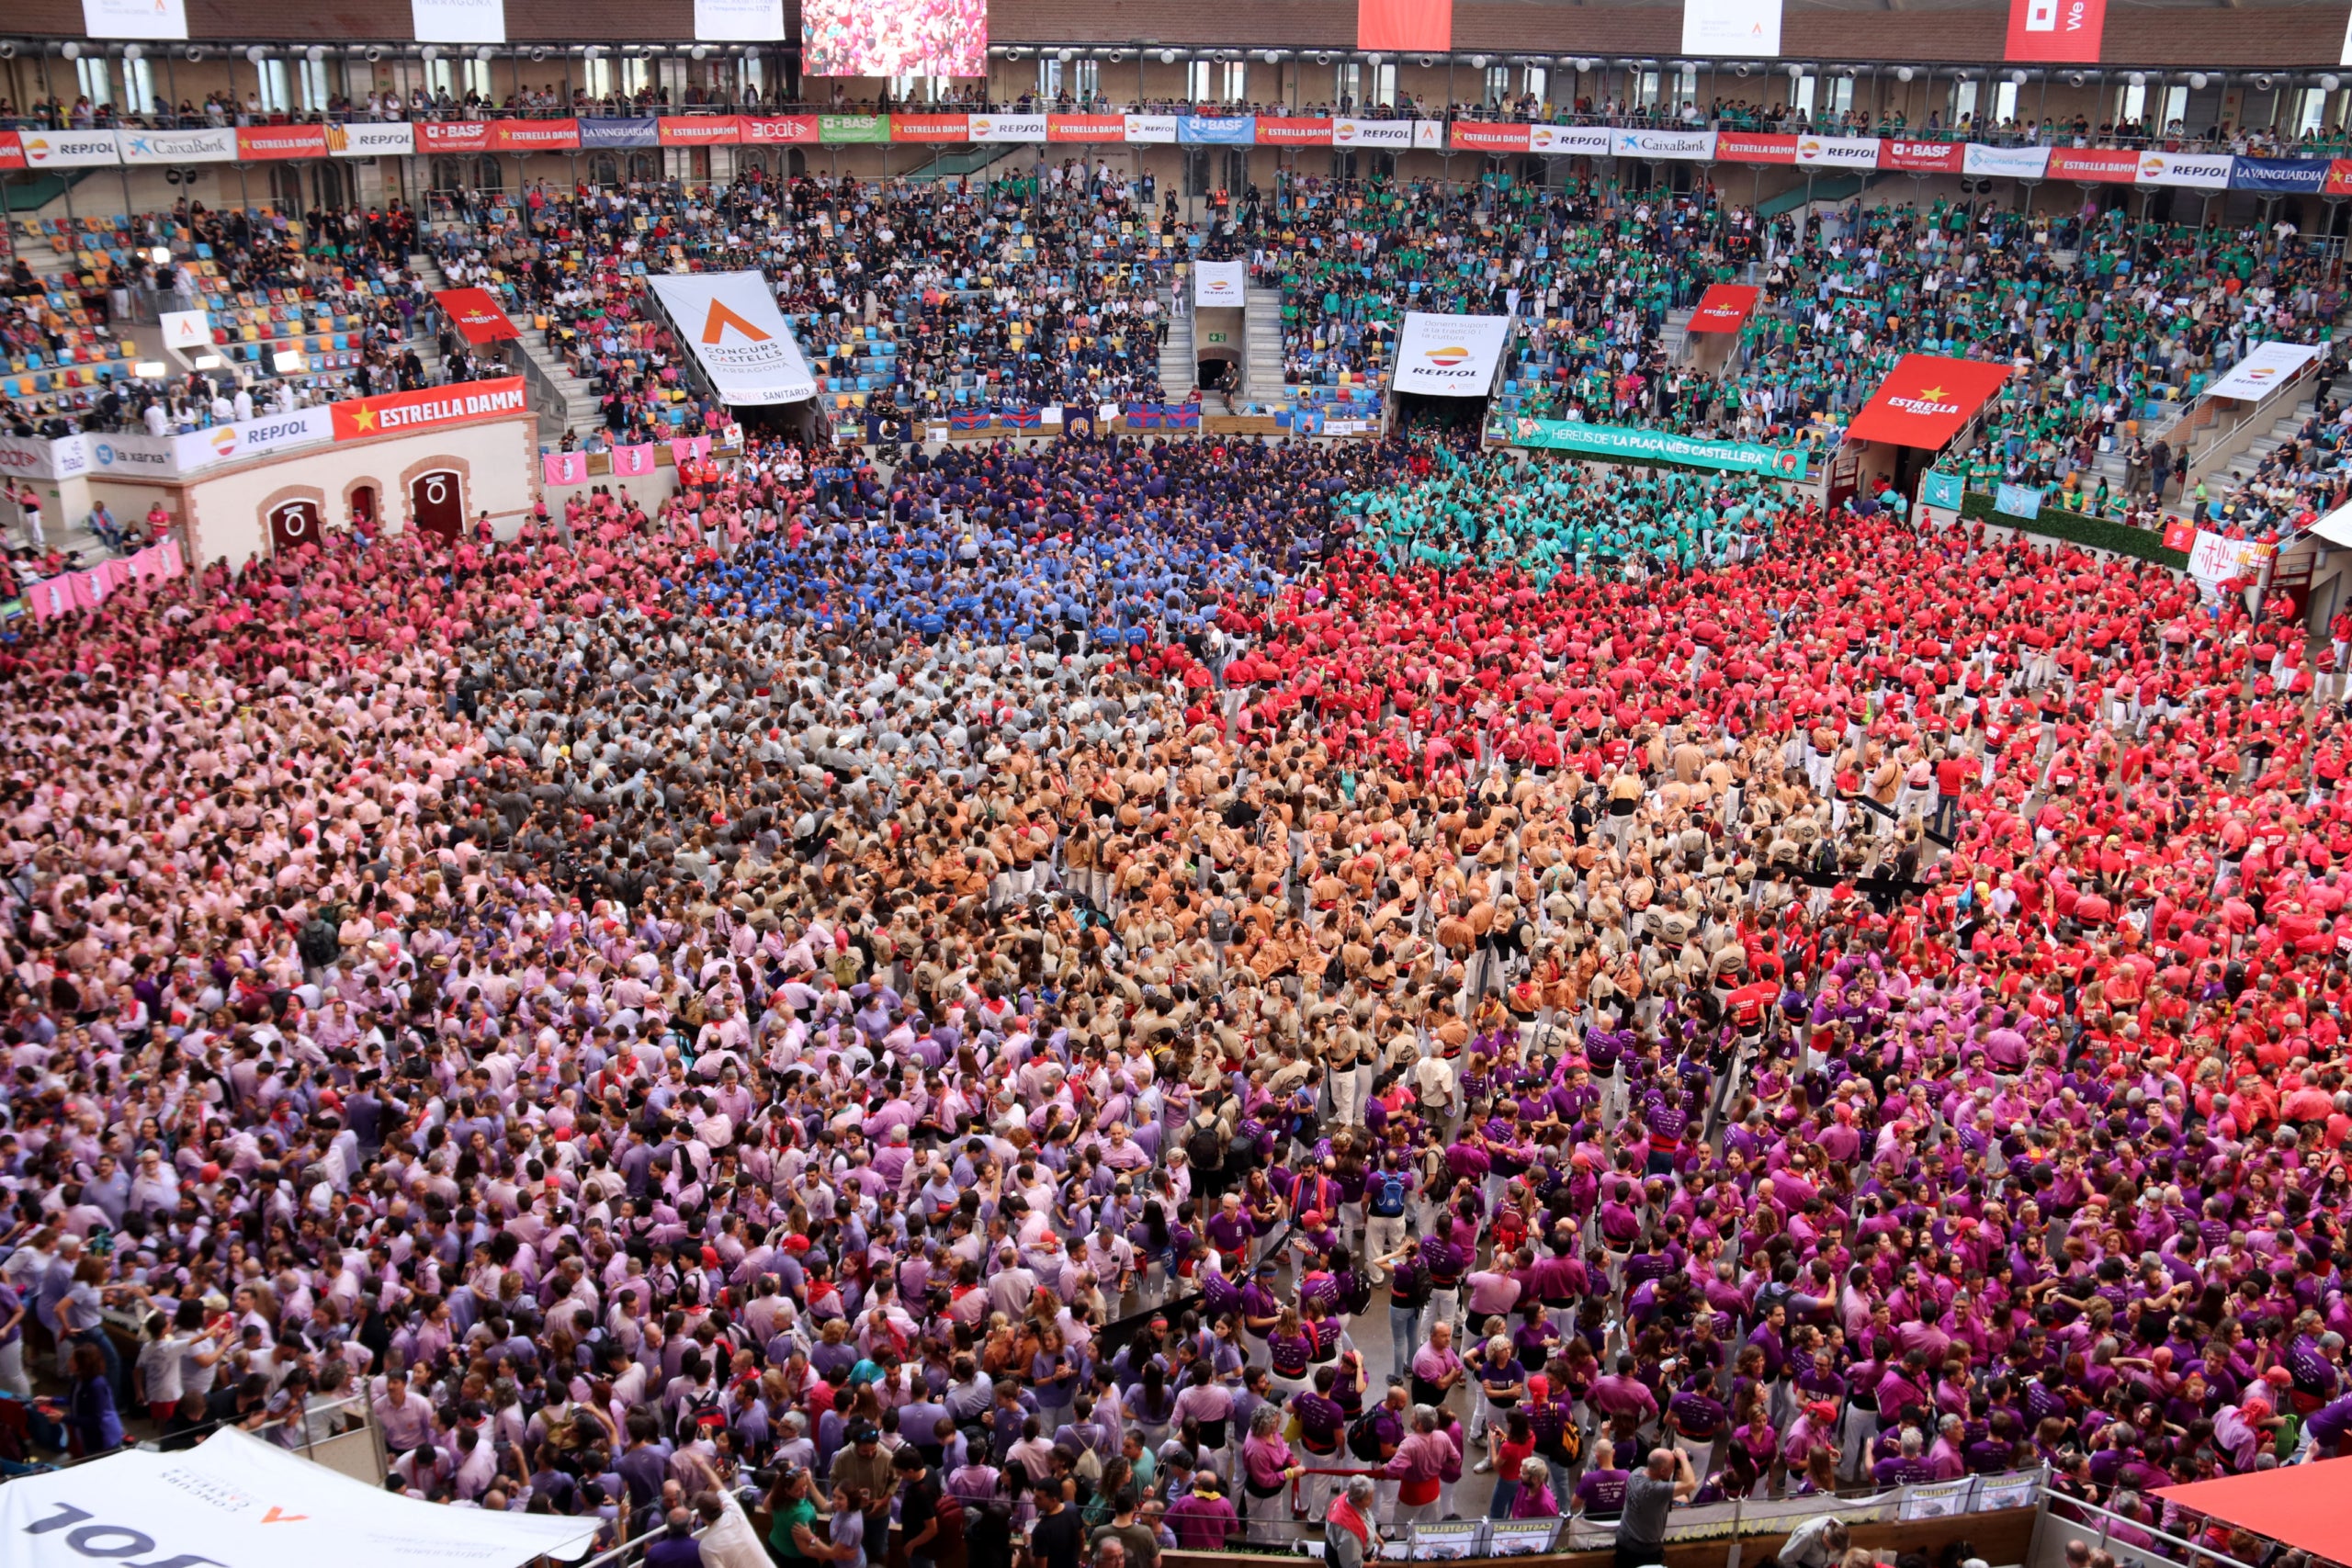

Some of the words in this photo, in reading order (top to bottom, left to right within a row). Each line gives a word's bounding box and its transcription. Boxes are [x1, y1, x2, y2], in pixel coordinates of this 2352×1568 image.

[2066, 2, 2084, 31] We
[842, 118, 876, 130] BASF
[903, 125, 941, 133] ESTRELLA
[943, 125, 967, 133] DAMM
[999, 124, 1044, 133] REPSOL
[1060, 125, 1099, 133] ESTRELLA
[1101, 125, 1123, 133] DAMM
[1208, 119, 1242, 130] BASF
[447, 124, 484, 137] BASF
[512, 131, 551, 140] ESTRELLA
[552, 130, 577, 139] DAMM
[582, 129, 596, 137] LA
[597, 128, 654, 137] VANGUARDIA
[673, 127, 711, 136] ESTRELLA
[713, 126, 738, 135] DAMM
[1268, 128, 1306, 136] ESTRELLA
[1307, 128, 1331, 137] DAMM
[1363, 130, 1409, 139] REPSOL
[252, 137, 295, 149] ESTRELLA
[296, 136, 323, 148] DAMM
[359, 134, 411, 144] REPSOL
[1464, 132, 1502, 141] ESTRELLA
[1503, 134, 1528, 143] DAMM
[1561, 136, 1607, 146] REPSOL
[60, 142, 114, 154] REPSOL
[153, 138, 227, 154] CaixaBank
[1641, 138, 1706, 152] CaixaBank
[1730, 144, 1769, 153] ESTRELLA
[1770, 145, 1794, 155] DAMM
[1913, 144, 1951, 157] BASF
[1827, 148, 1876, 158] REPSOL
[2064, 161, 2106, 171] ESTRELLA
[2107, 163, 2136, 173] DAMM
[2173, 165, 2227, 177] REPSOL
[2236, 167, 2252, 178] LA
[2251, 168, 2322, 181] VANGUARDIA
[1425, 320, 1457, 328] Donem
[704, 343, 778, 354] CONCURS
[708, 350, 783, 363] CASTELLS
[717, 362, 790, 374] TARRAGONA
[1412, 367, 1477, 377] REPSOL
[763, 387, 809, 400] SANITARIS
[379, 399, 463, 428] ESTRELLA
[466, 389, 524, 414] DAMM
[1887, 397, 1959, 414] ESTRELLA
[1905, 407, 1931, 416] DAMM
[247, 421, 308, 444] REPSOL
[1552, 429, 1593, 443] HEREUS
[1595, 434, 1609, 445] DE
[1630, 437, 1664, 452] PLAÇA
[1667, 441, 1690, 455] MÉS
[116, 449, 127, 460] la
